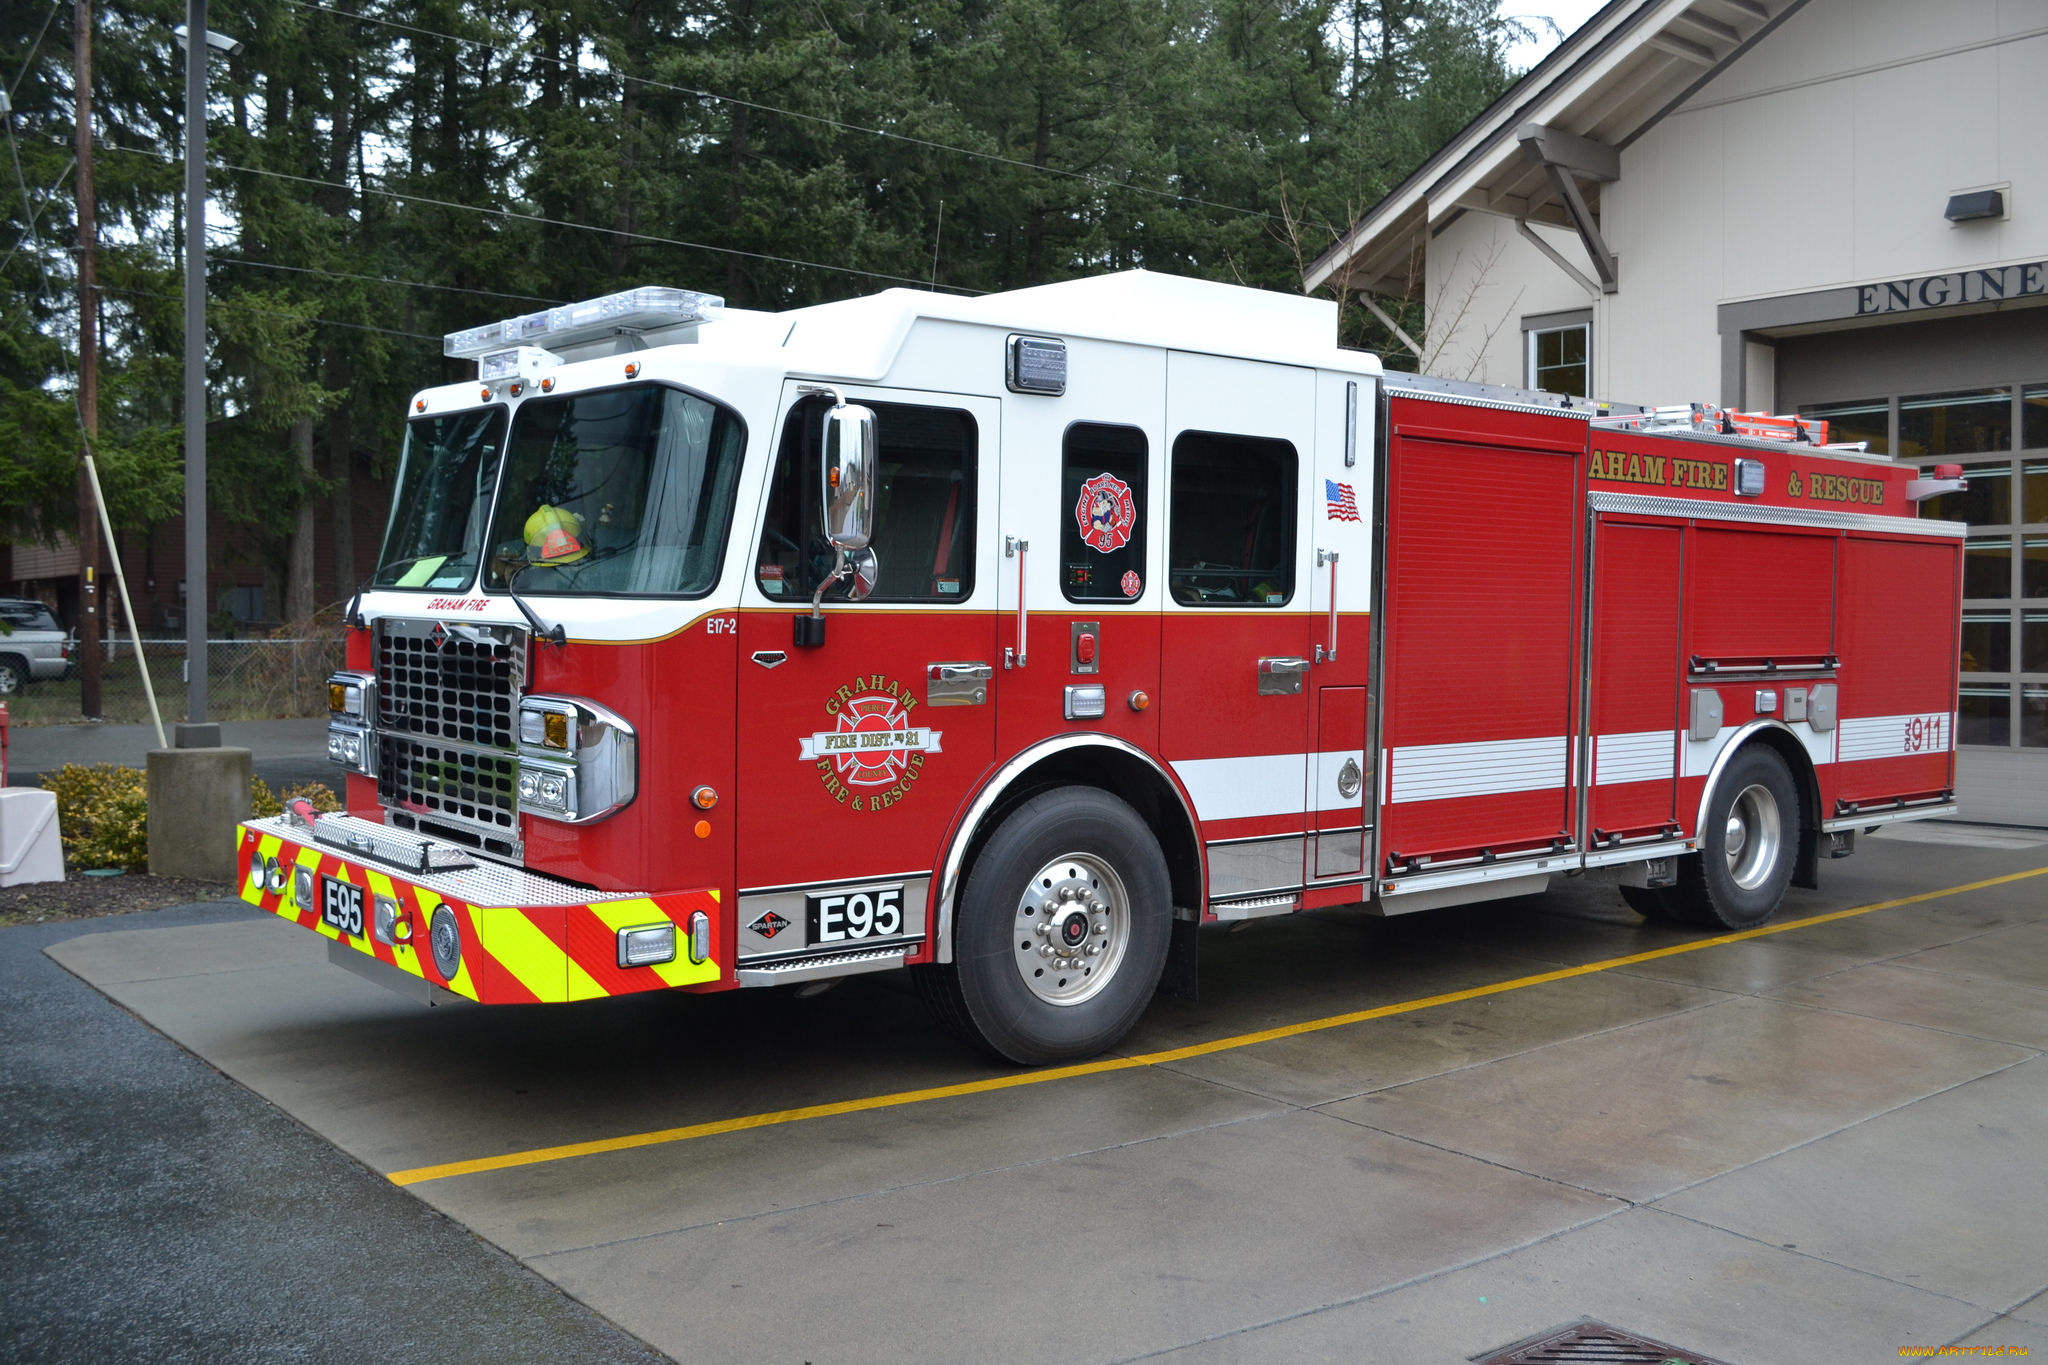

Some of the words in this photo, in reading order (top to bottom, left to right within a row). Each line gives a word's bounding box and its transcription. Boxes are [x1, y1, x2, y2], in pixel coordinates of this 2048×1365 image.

[1855, 263, 2045, 315] ENGINE
[1672, 457, 1728, 491] FIRE
[1788, 470, 1802, 497] &
[1809, 472, 1884, 505] RESCUE
[1081, 494, 1090, 527] ENGINE
[548, 536, 573, 554] E95
[1099, 533, 1113, 547] 95
[427, 598, 468, 610] GRAHAM
[464, 599, 490, 611] FIRE
[707, 618, 736, 634] E17-2
[825, 674, 919, 716] GRAHAM
[860, 704, 886, 712] PIERCE
[825, 734, 857, 749] FIRE
[861, 733, 894, 748] DIST.
[905, 731, 919, 746] 21
[1904, 717, 1912, 752] DIAL
[1912, 716, 1940, 751] 911
[817, 757, 850, 804] FIRE
[851, 794, 863, 811] &
[870, 753, 925, 812] RESCUE
[857, 769, 888, 779] COUNTY
[326, 879, 362, 934] E95
[819, 890, 901, 942] E95
[752, 920, 788, 931] SPARTAN
